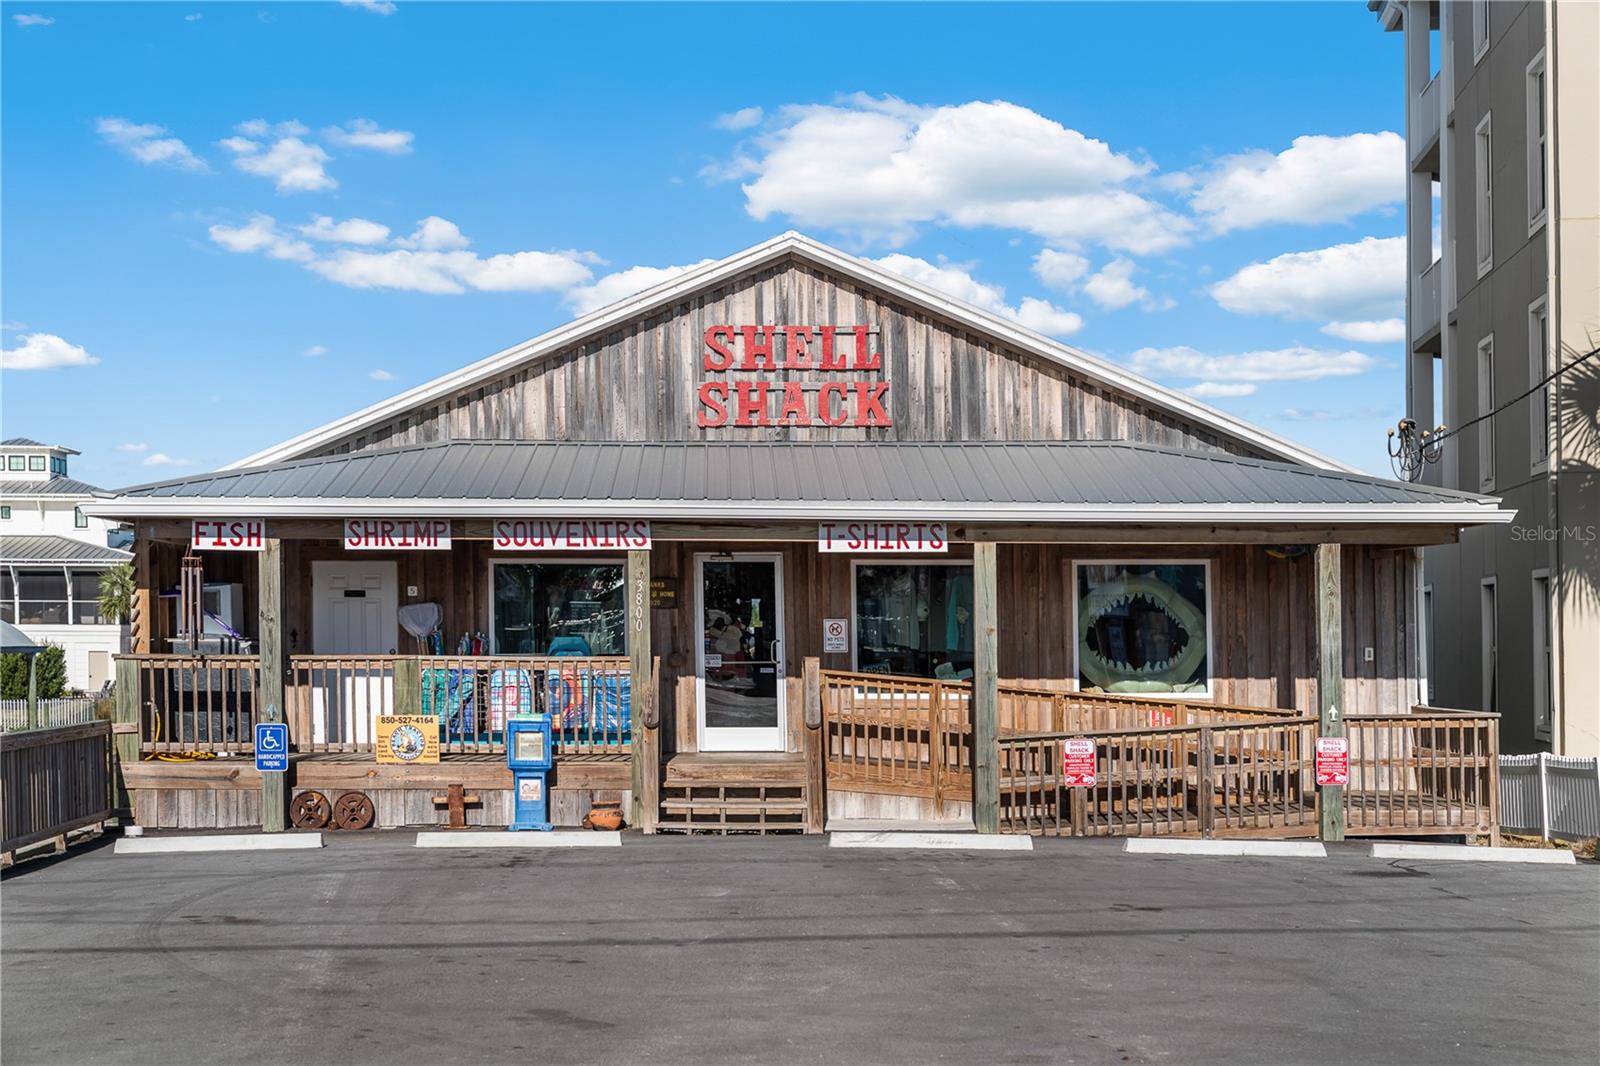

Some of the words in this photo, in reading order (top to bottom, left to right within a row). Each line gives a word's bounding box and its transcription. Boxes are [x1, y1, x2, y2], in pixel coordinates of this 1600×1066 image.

[704, 325, 881, 370] SHELL
[697, 382, 892, 427] SHACK
[194, 521, 262, 547] FISH
[347, 520, 448, 547] SHRIMP
[496, 521, 647, 547] SOUVENIRS
[821, 523, 944, 549] T-SHIRTS
[380, 716, 434, 724] 850-527-4164
